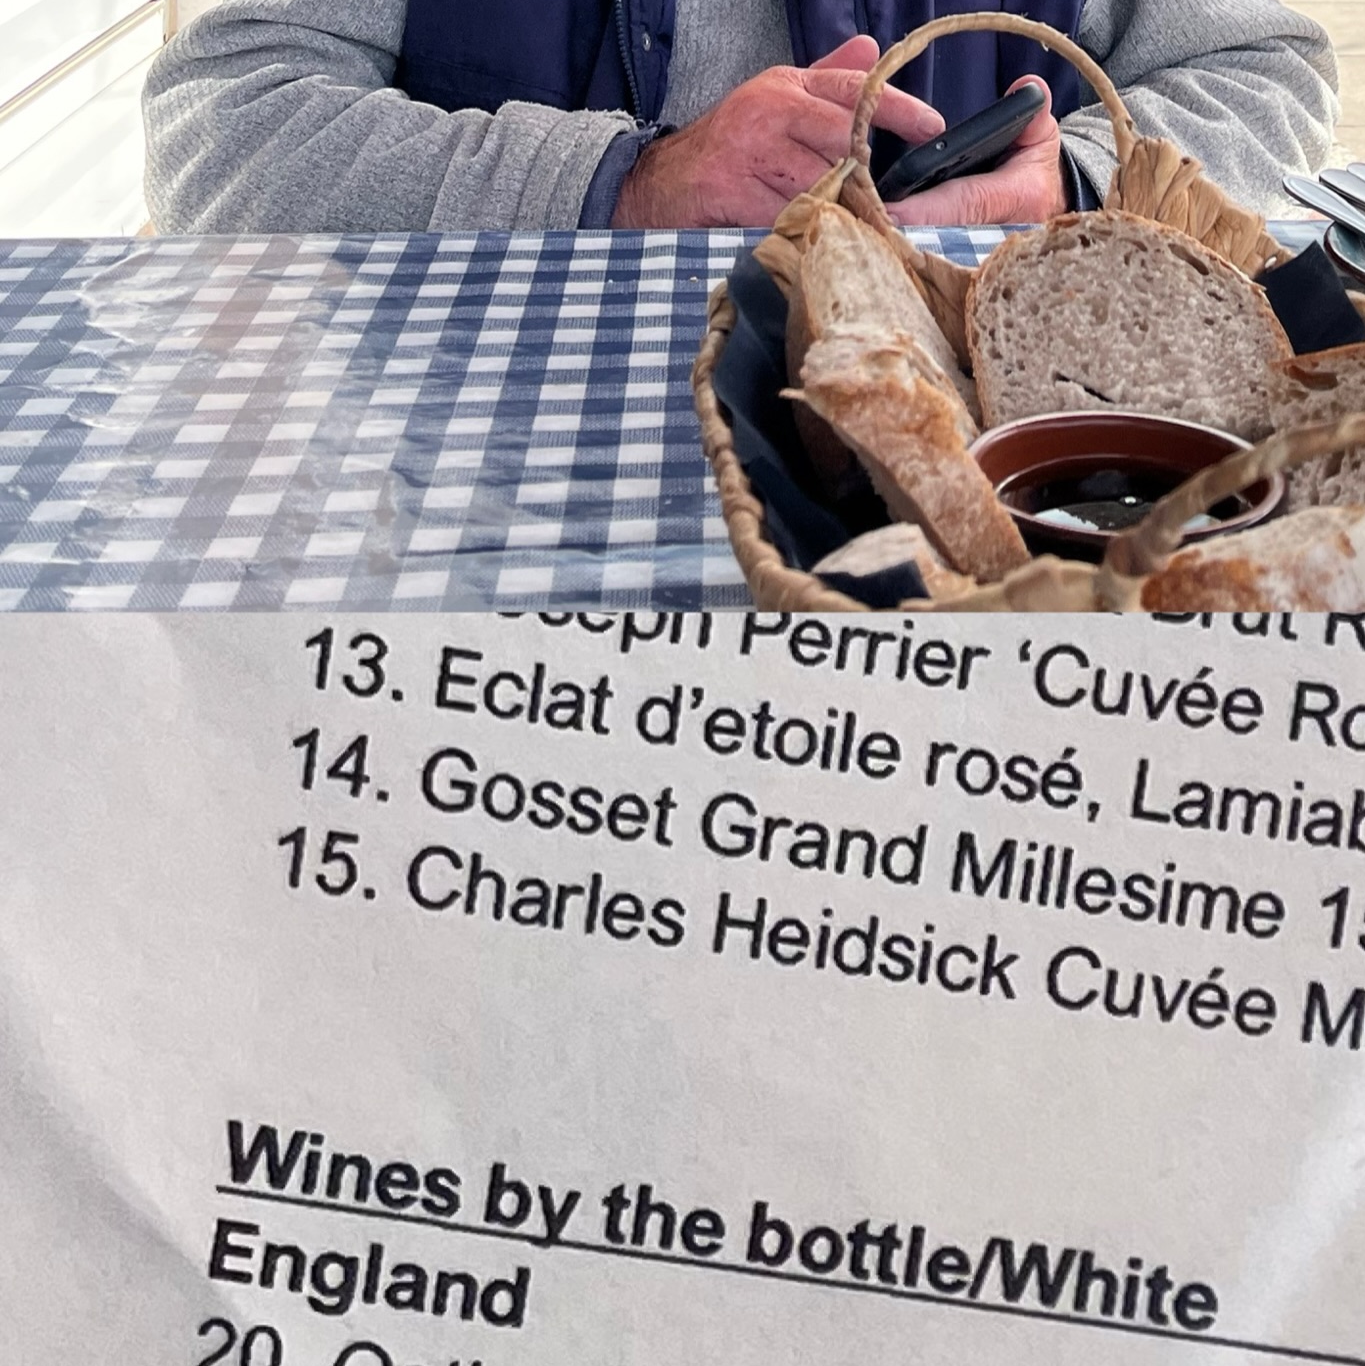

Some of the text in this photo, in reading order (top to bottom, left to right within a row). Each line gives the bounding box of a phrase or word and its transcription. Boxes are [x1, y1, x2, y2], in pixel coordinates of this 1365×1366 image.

[305, 627, 403, 702] 13.
[435, 645, 614, 735] Eclat
[636, 684, 901, 779] d’etoile
[925, 742, 1100, 823] rosé,
[740, 613, 991, 690] Perrier
[1018, 639, 1264, 735] ‘Cuvée
[278, 826, 375, 900] 15.
[406, 845, 686, 947] Charles
[712, 891, 1020, 999] Heidsick
[1046, 945, 1277, 1036] Cuvée
[293, 727, 389, 802] 14.
[421, 747, 678, 847] Gosset
[700, 792, 928, 885] Grand
[950, 831, 1285, 939] Millesime
[208, 1217, 531, 1328] England
[227, 1119, 1218, 1331] Wines by the bottle/White
